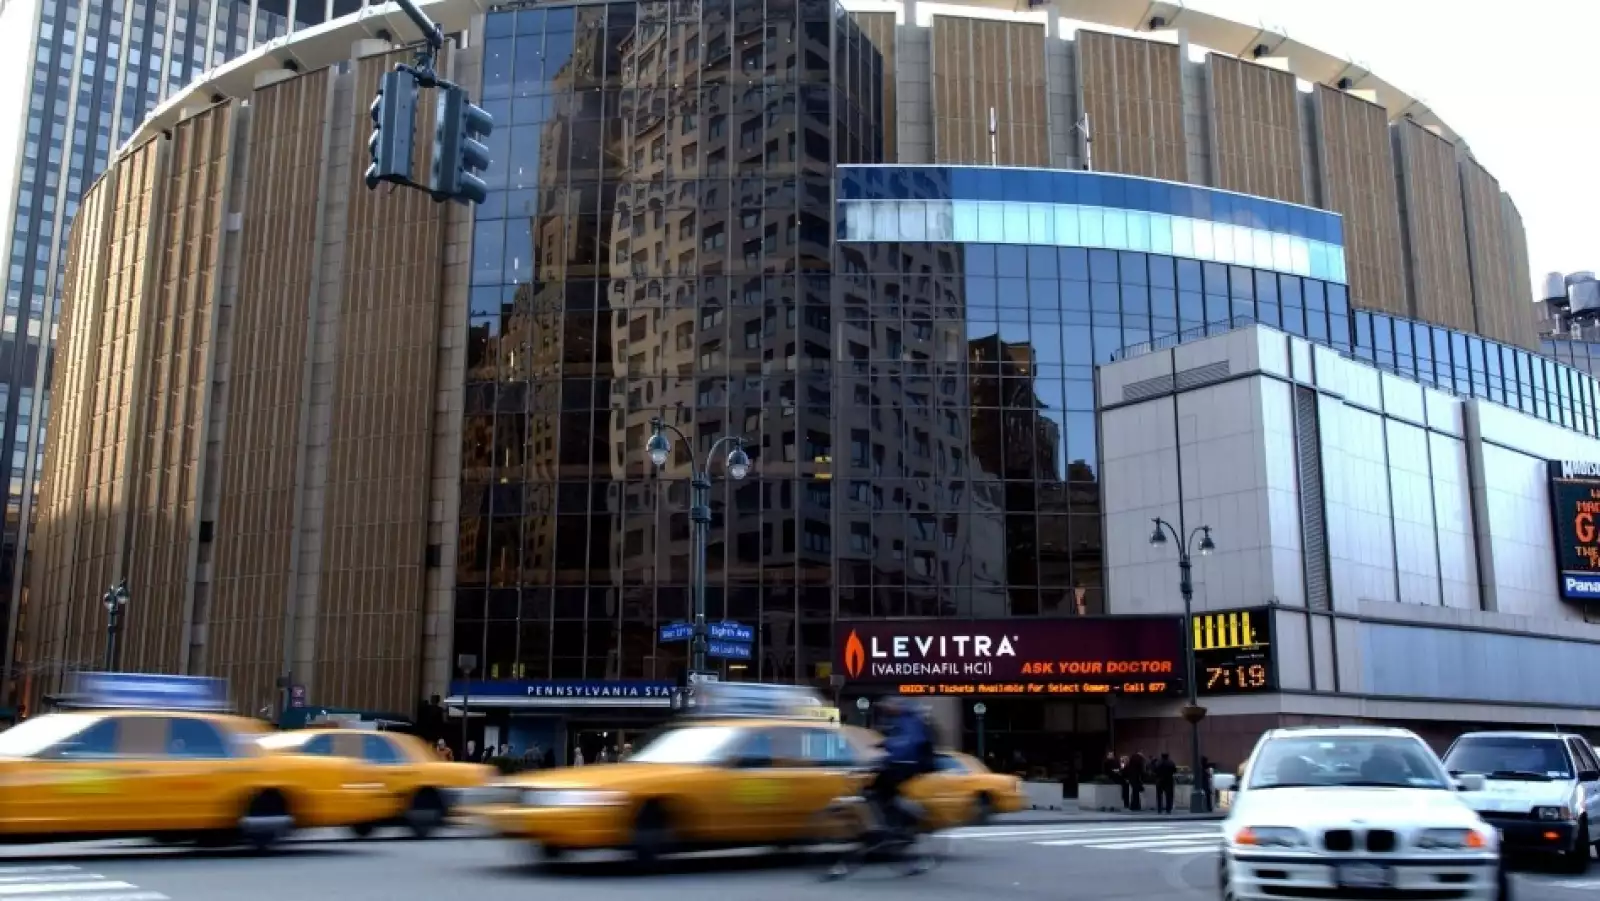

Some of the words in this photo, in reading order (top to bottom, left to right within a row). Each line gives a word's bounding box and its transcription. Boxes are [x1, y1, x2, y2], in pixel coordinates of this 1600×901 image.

[871, 635, 1016, 658] LEVITRA
[1022, 662, 1053, 674] ASK
[1059, 661, 1103, 673] YOUR
[1107, 660, 1172, 673] DOCTOR
[1206, 665, 1265, 689] 7:19
[527, 686, 638, 696] PENNSYLVANIA
[1047, 683, 1079, 693] Select
[1123, 683, 1145, 693] Call
